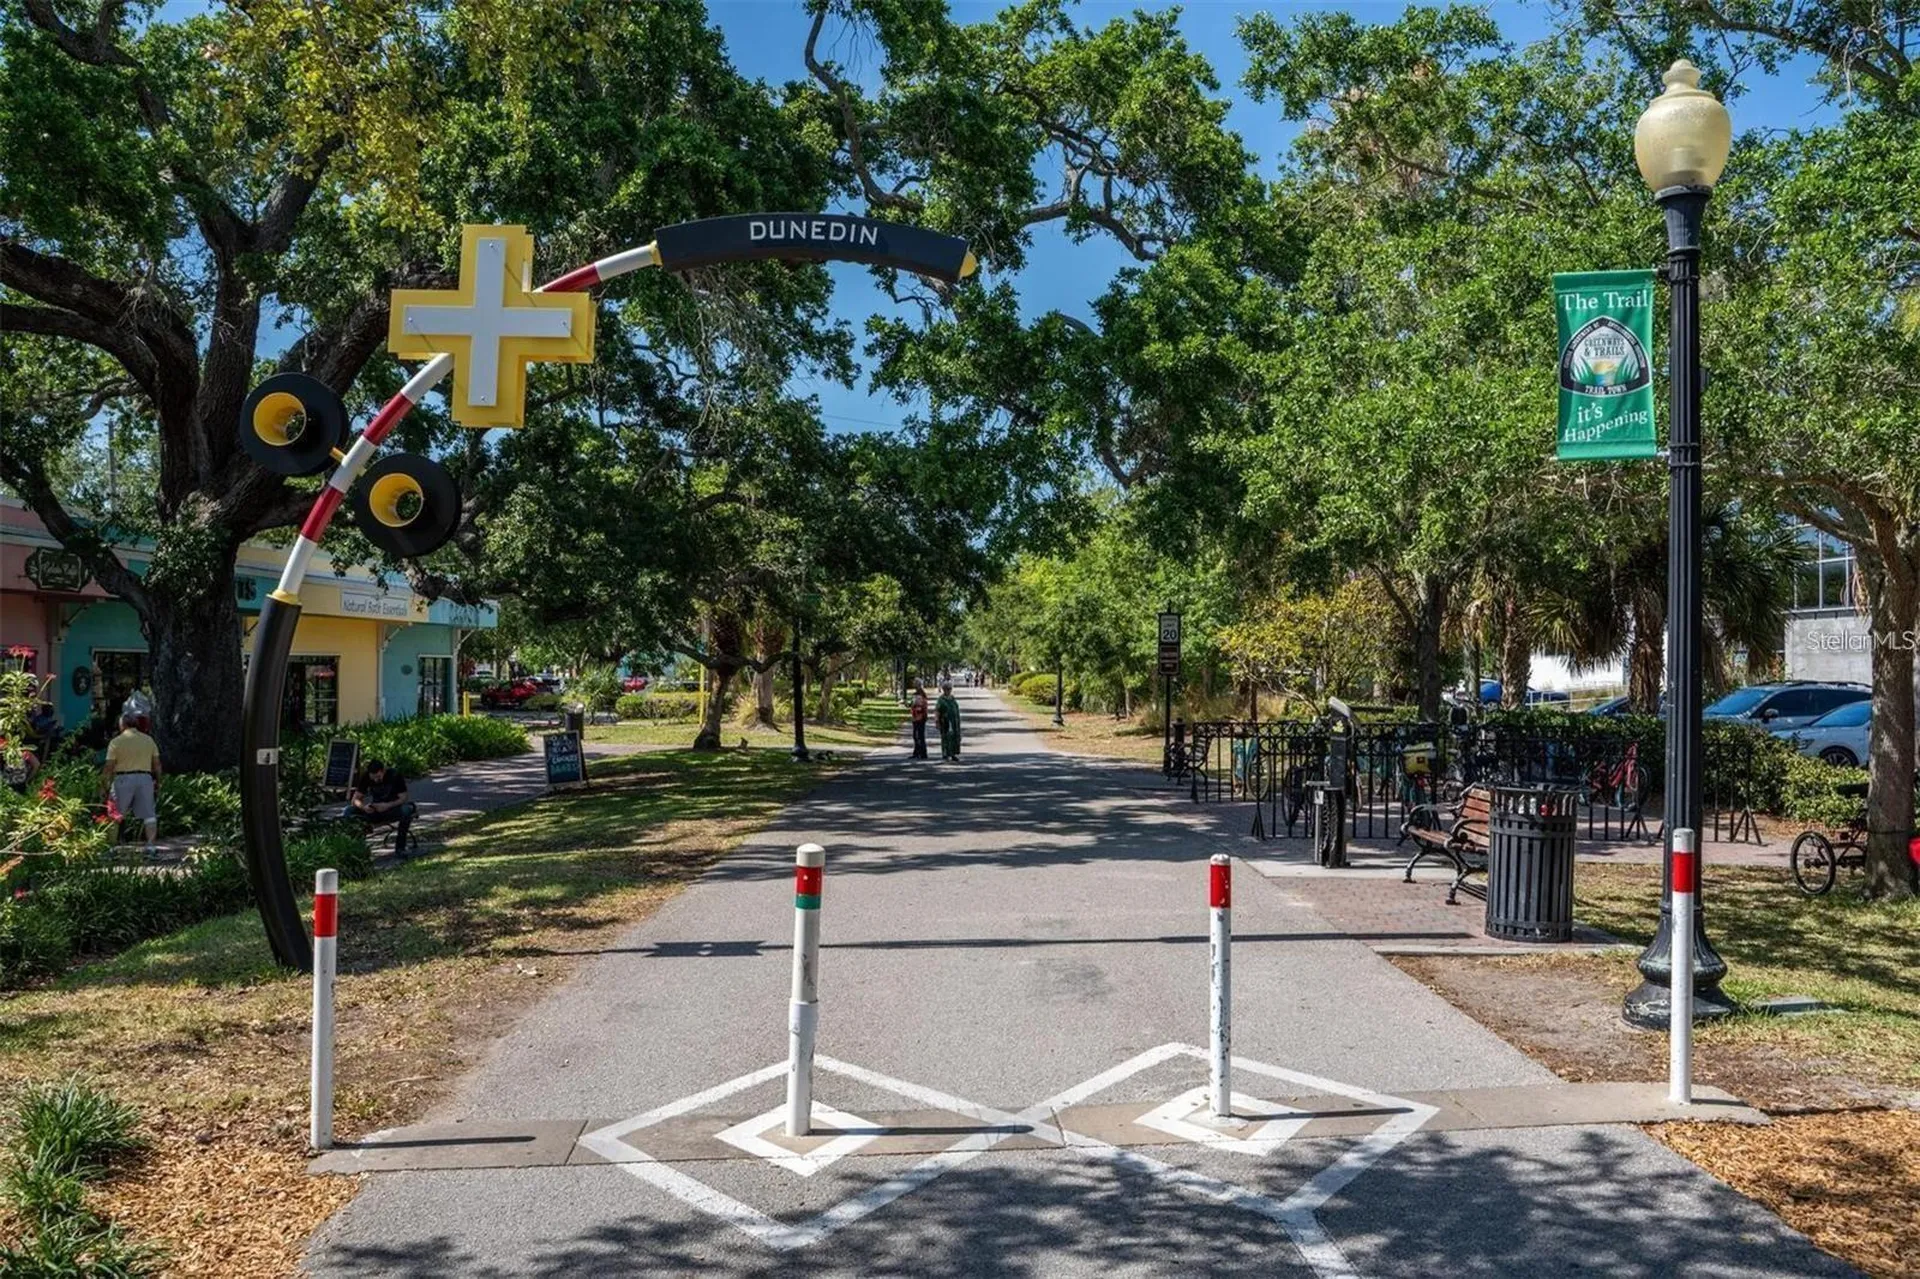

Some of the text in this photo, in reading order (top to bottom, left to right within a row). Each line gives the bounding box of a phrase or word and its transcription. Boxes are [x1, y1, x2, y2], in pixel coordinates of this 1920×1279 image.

[749, 220, 879, 246] DUNEDIN
[1560, 290, 1649, 311] The Trail
[1584, 347, 1625, 357] & TRAILS
[1585, 384, 1628, 395] TRAIL TOWN
[1577, 402, 1603, 424] it's
[1564, 410, 1649, 443] Happening
[1163, 629, 1177, 640] 20
